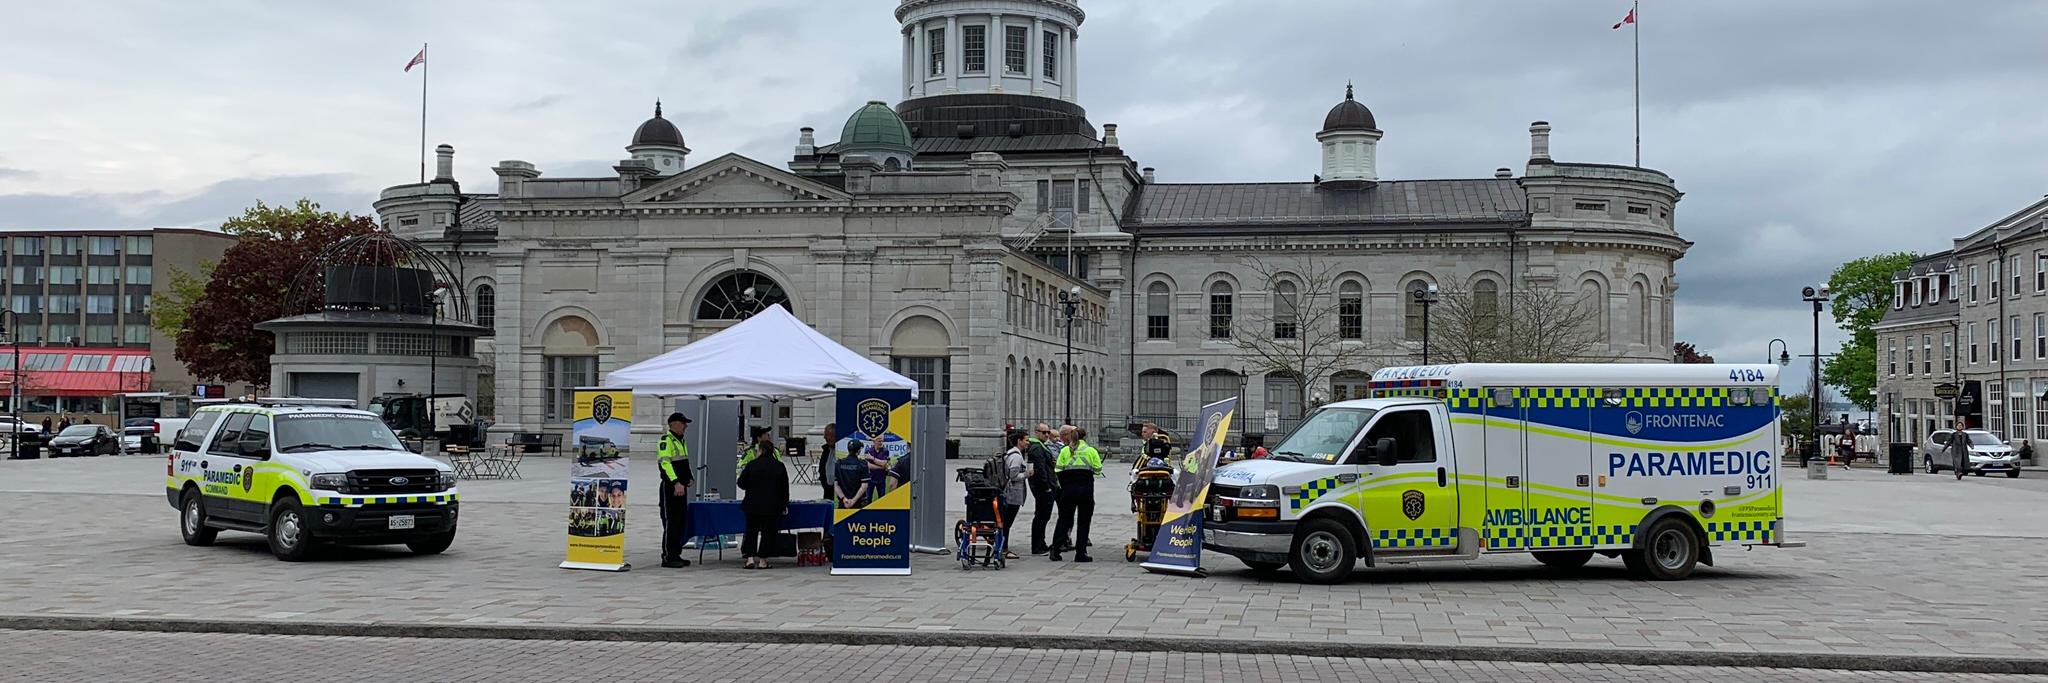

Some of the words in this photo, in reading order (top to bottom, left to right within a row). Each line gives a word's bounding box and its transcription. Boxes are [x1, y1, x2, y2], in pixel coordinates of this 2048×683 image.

[1374, 361, 1456, 379] PARAMEDIC
[1729, 369, 1765, 382] 4184
[1645, 414, 1725, 428] FRONTENAC
[180, 459, 192, 473] 911
[1609, 450, 1771, 477] PARAMEDIC
[203, 470, 241, 486] PARAMEDIC
[1746, 474, 1771, 489] 911
[205, 484, 229, 496] COMMAND
[1482, 507, 1592, 526] AMBULANCE
[847, 522, 867, 532] We
[869, 522, 896, 535] Help
[1170, 524, 1185, 535] We
[852, 535, 891, 548] People
